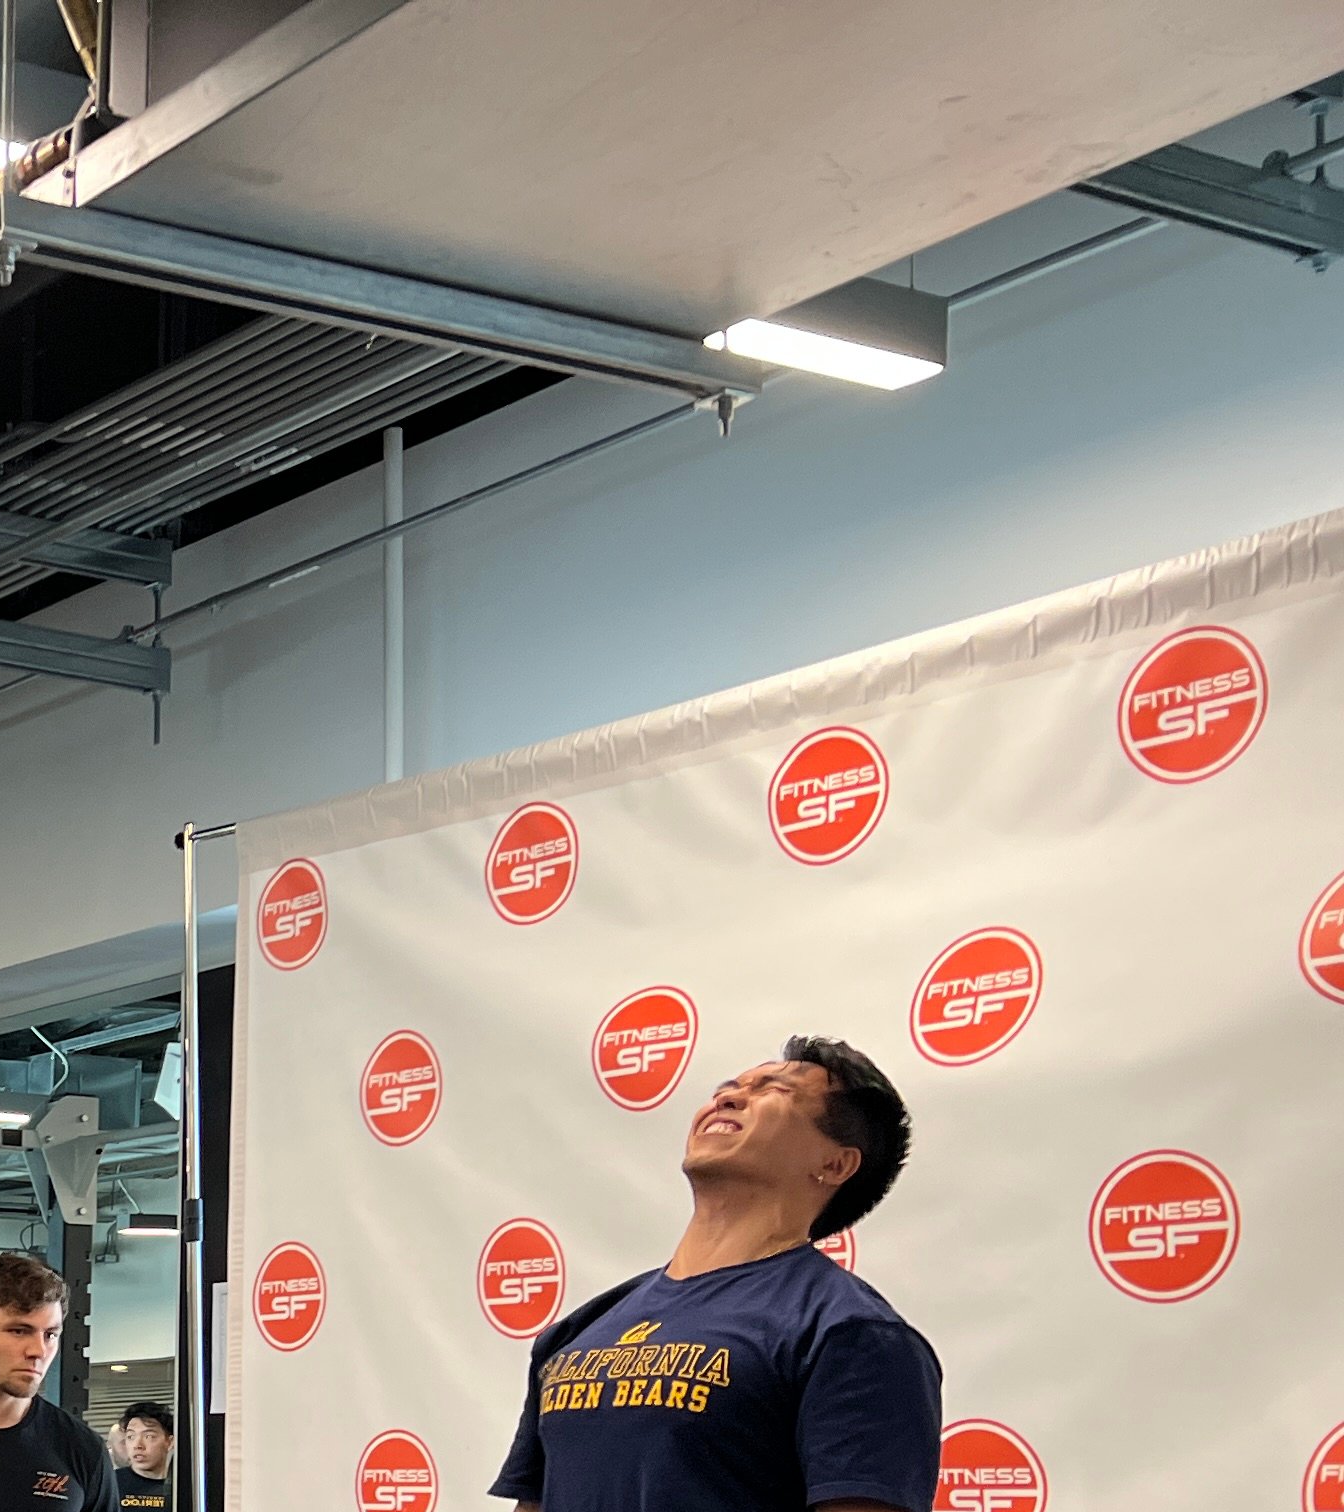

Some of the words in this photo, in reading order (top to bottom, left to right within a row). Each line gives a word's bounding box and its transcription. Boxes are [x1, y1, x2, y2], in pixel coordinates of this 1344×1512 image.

[1132, 667, 1251, 714] FITNESS
[1157, 698, 1231, 737] SF
[779, 764, 876, 801] FITNESS
[797, 790, 856, 825] SF
[495, 836, 569, 868] FITNESS
[509, 861, 557, 890] SF
[263, 889, 320, 918] FITNESS
[274, 913, 313, 940] SF
[926, 967, 1030, 1000] FITNESS
[942, 997, 1005, 1027] SF
[602, 1021, 688, 1048] FITNESS
[615, 1044, 667, 1074] SF
[368, 1065, 434, 1088] FITNESS
[379, 1086, 423, 1113] SF
[1104, 1197, 1223, 1226] FITNESS
[1127, 1226, 1200, 1259] SF
[486, 1256, 556, 1277] FITNESS
[261, 1277, 319, 1295] FITNESS
[499, 1276, 544, 1305] SF
[270, 1295, 308, 1321] SF
[612, 1379, 712, 1413] BEARS
[362, 1468, 430, 1484] FITNESS
[374, 1485, 417, 1512] SF
